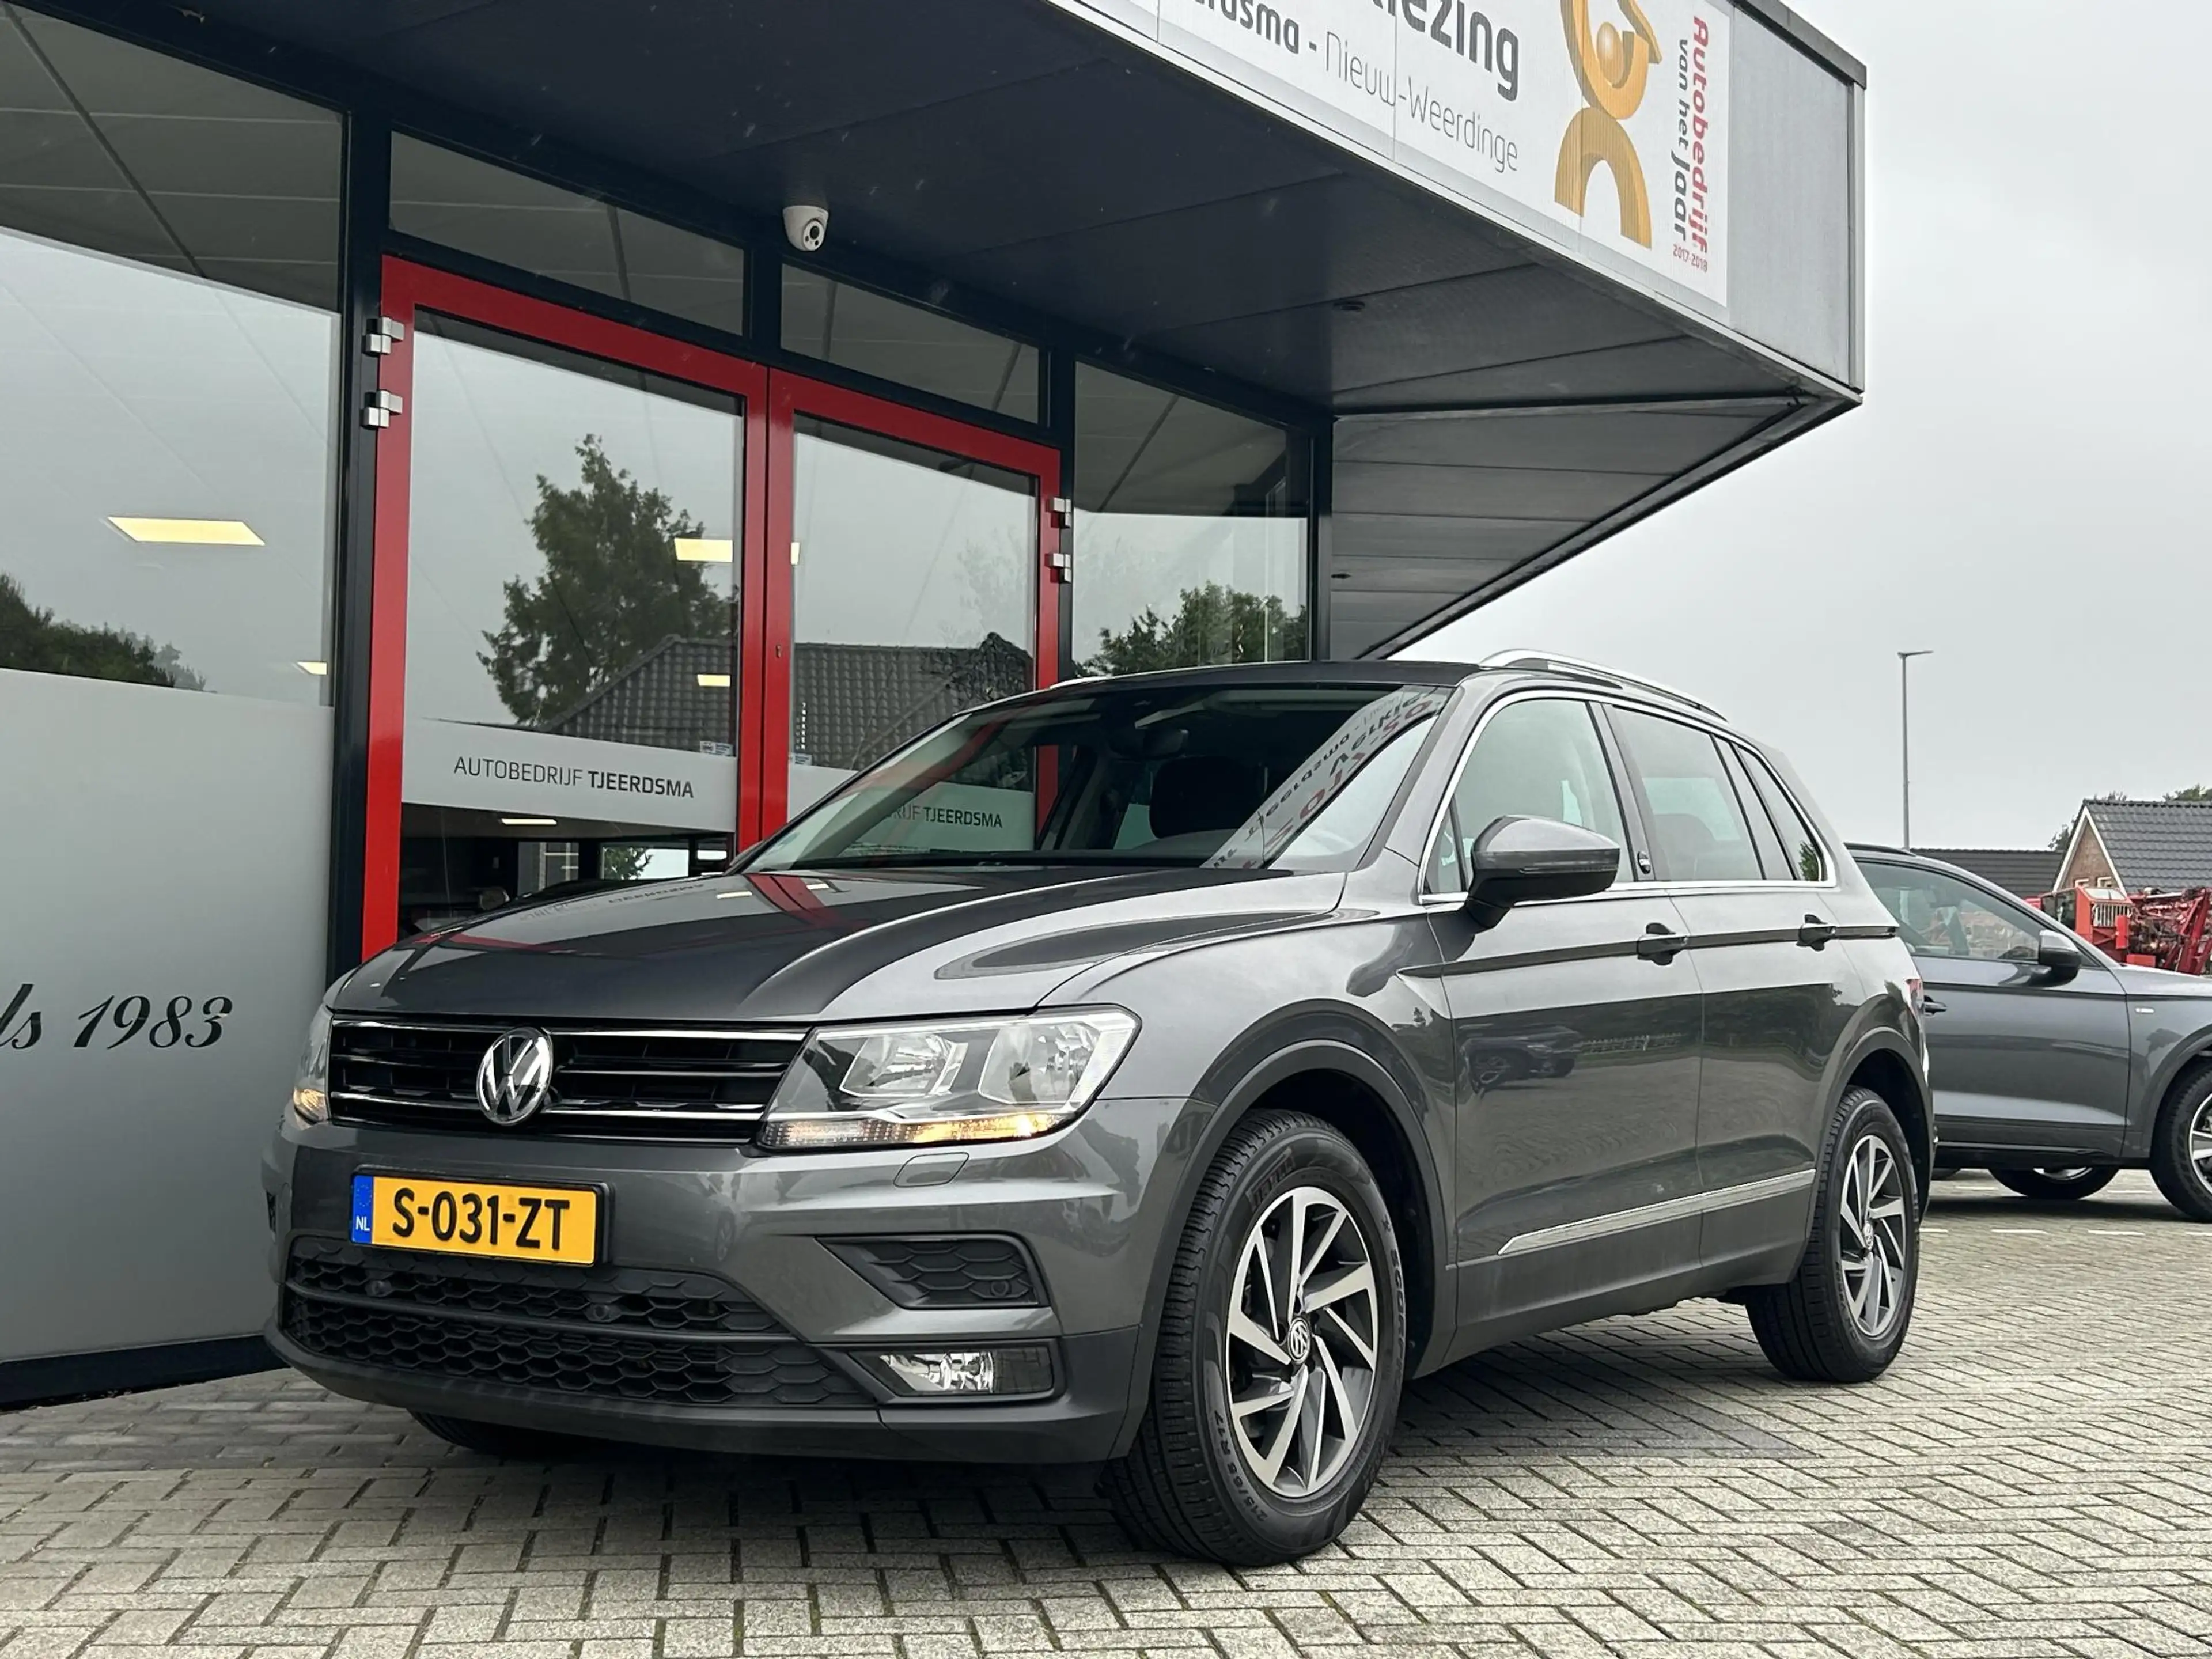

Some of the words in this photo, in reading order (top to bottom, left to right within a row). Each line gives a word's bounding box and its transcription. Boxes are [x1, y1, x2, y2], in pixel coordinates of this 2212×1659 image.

[1679, 39, 1688, 90] van
[1326, 31, 1518, 173] Nieuw-Weerdinge
[1679, 99, 1690, 147] het
[1689, 16, 1709, 254] Autobedrijf
[454, 756, 582, 786] AUTOBEDRIJF
[588, 770, 694, 798] TJEERDSMA
[923, 806, 1003, 828] TJEERDSMA
[73, 995, 233, 1049] 1983
[355, 1216, 370, 1232] NL
[392, 1187, 570, 1251] S-031-ZT
